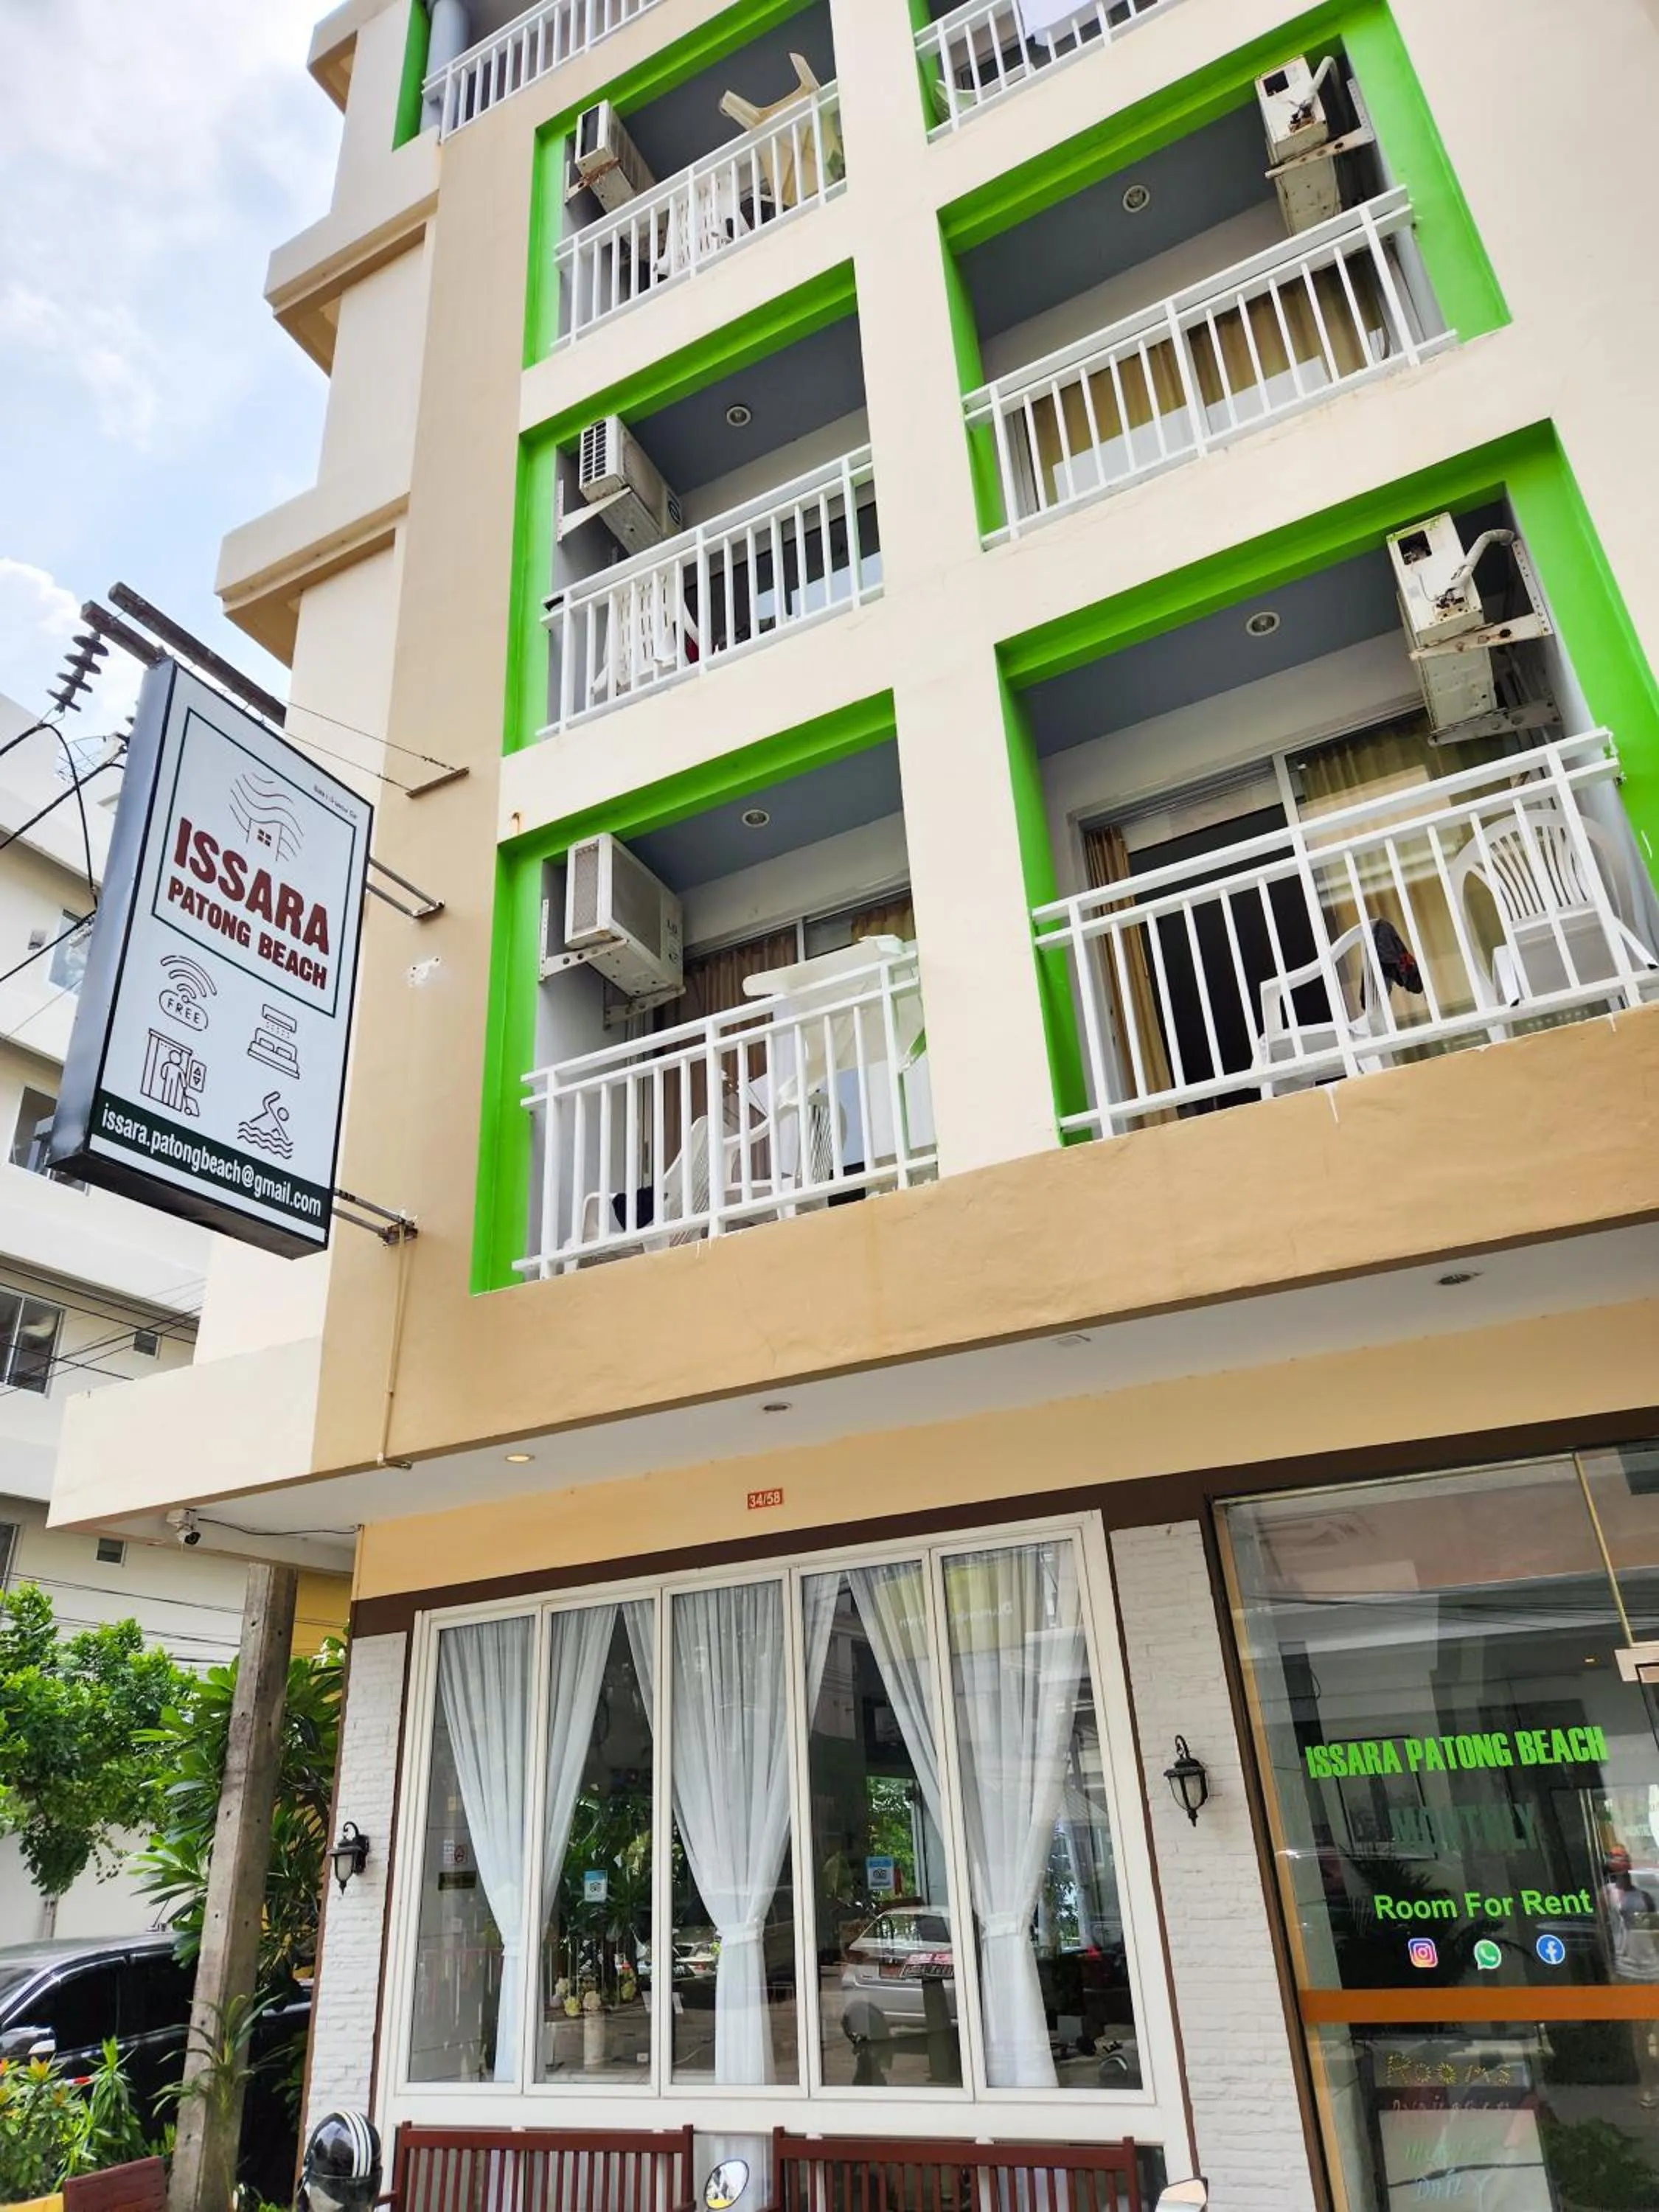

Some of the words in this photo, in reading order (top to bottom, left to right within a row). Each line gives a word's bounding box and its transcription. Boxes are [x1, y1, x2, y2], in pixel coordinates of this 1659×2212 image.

[174, 816, 330, 956] ISSARA
[167, 875, 251, 948] PATONG
[258, 931, 327, 990] BEACH
[167, 998, 200, 1024] FREE
[102, 1103, 321, 1217] issara.patongbeach@gmail.com
[748, 1491, 780, 1508] 34/58
[1305, 1739, 1403, 1778] ISSARA
[1404, 1732, 1514, 1772] PATONG
[1514, 1725, 1609, 1765] BEACH
[1374, 1893, 1458, 1919] Room
[1464, 1892, 1514, 1917] For
[1520, 1888, 1594, 1916] Rent
